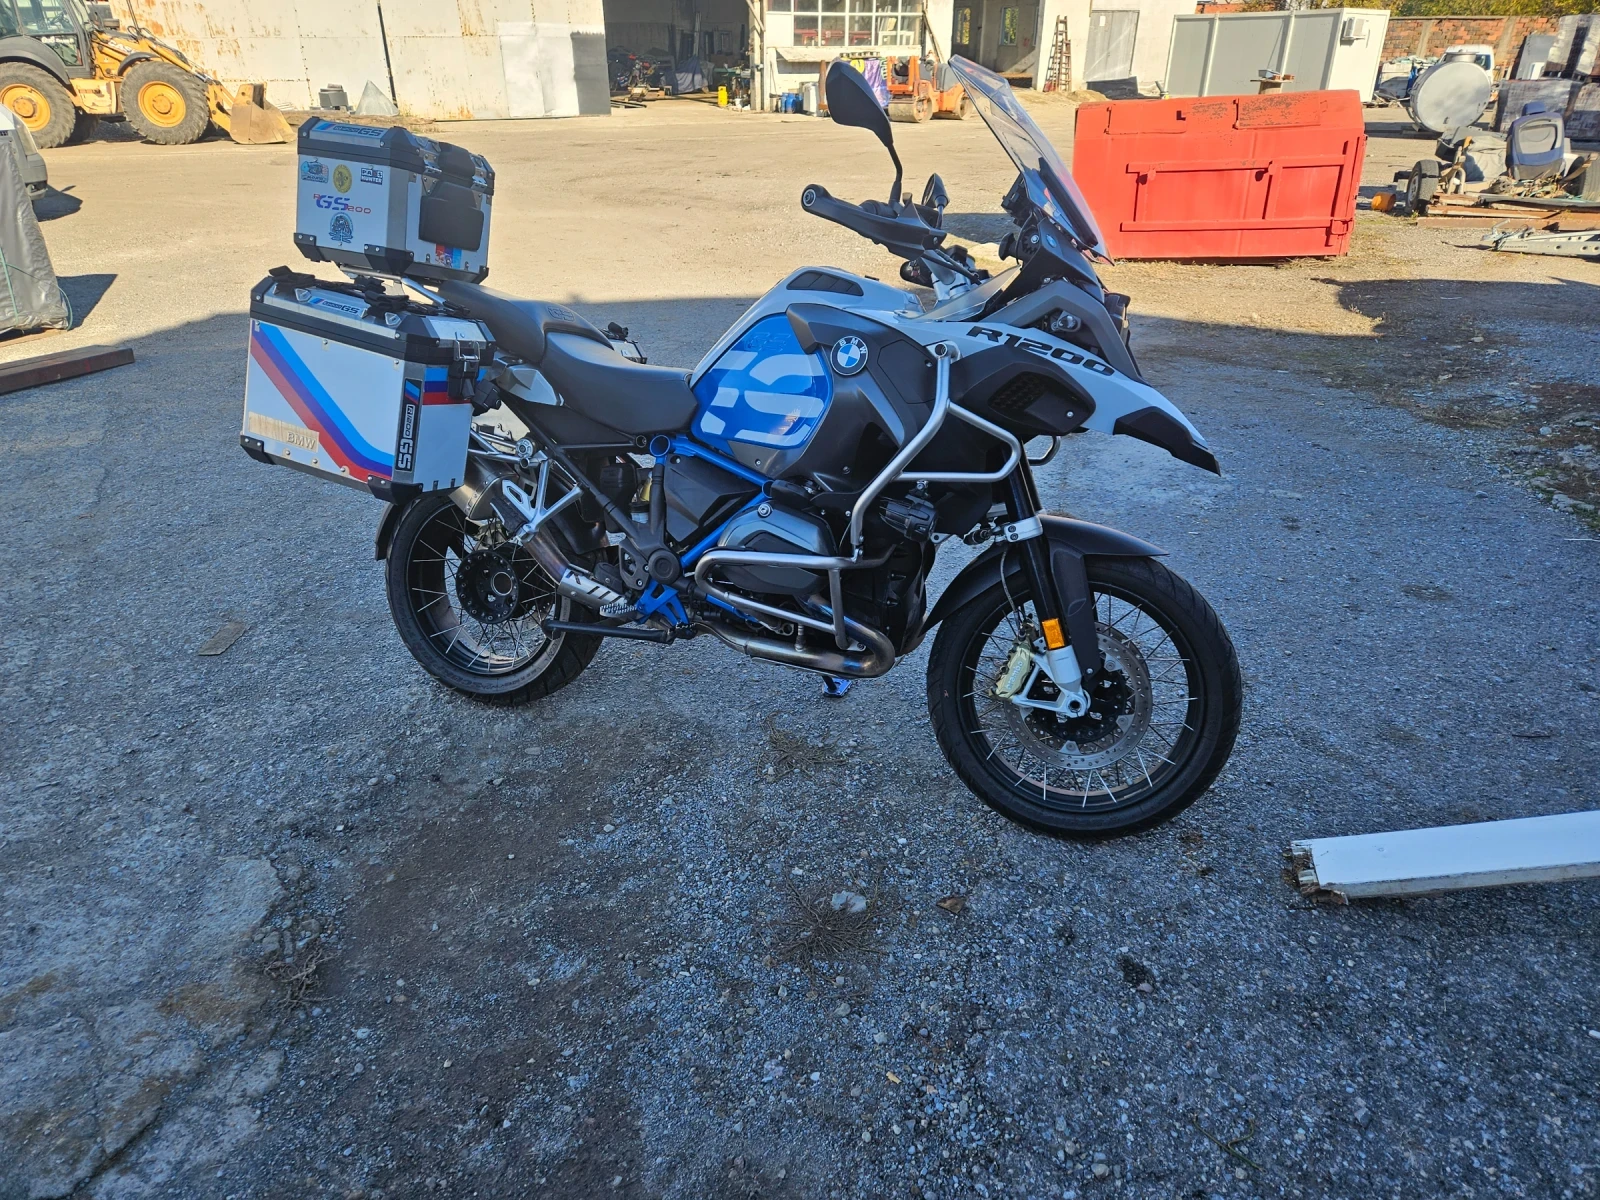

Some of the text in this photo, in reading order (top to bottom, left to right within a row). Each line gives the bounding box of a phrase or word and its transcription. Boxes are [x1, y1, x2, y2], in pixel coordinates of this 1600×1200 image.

[316, 194, 350, 210] GS
[838, 337, 868, 354] BMW
[966, 326, 1115, 376] R1200
[286, 431, 316, 450] BMW
[398, 404, 415, 470] R1200 GS
